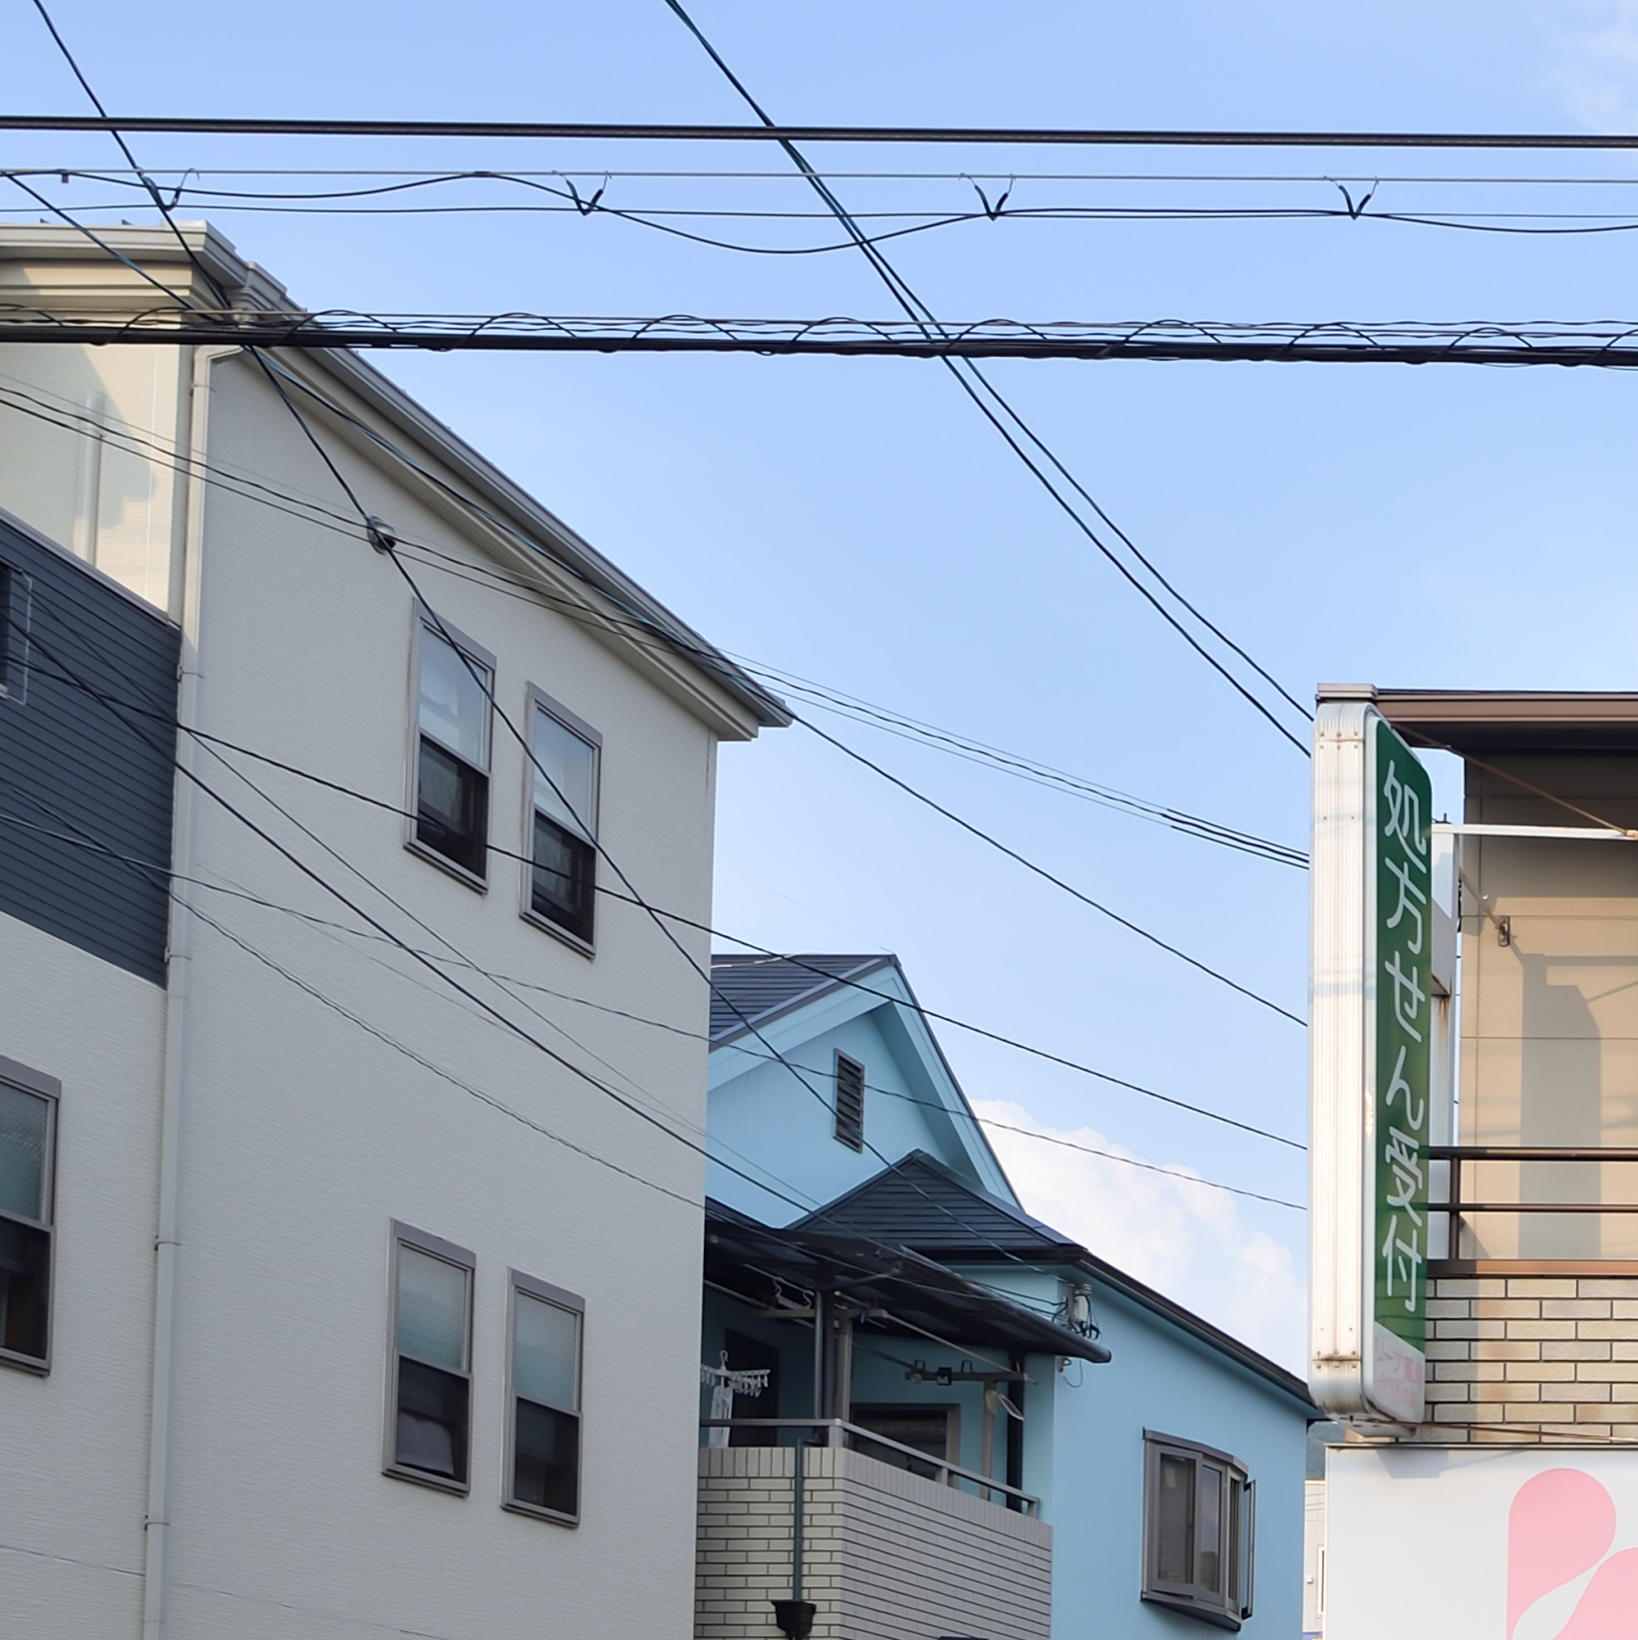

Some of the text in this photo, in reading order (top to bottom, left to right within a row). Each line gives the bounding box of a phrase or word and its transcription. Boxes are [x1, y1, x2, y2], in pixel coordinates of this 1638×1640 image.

[1383, 759, 1428, 1312] 処方せん受付
